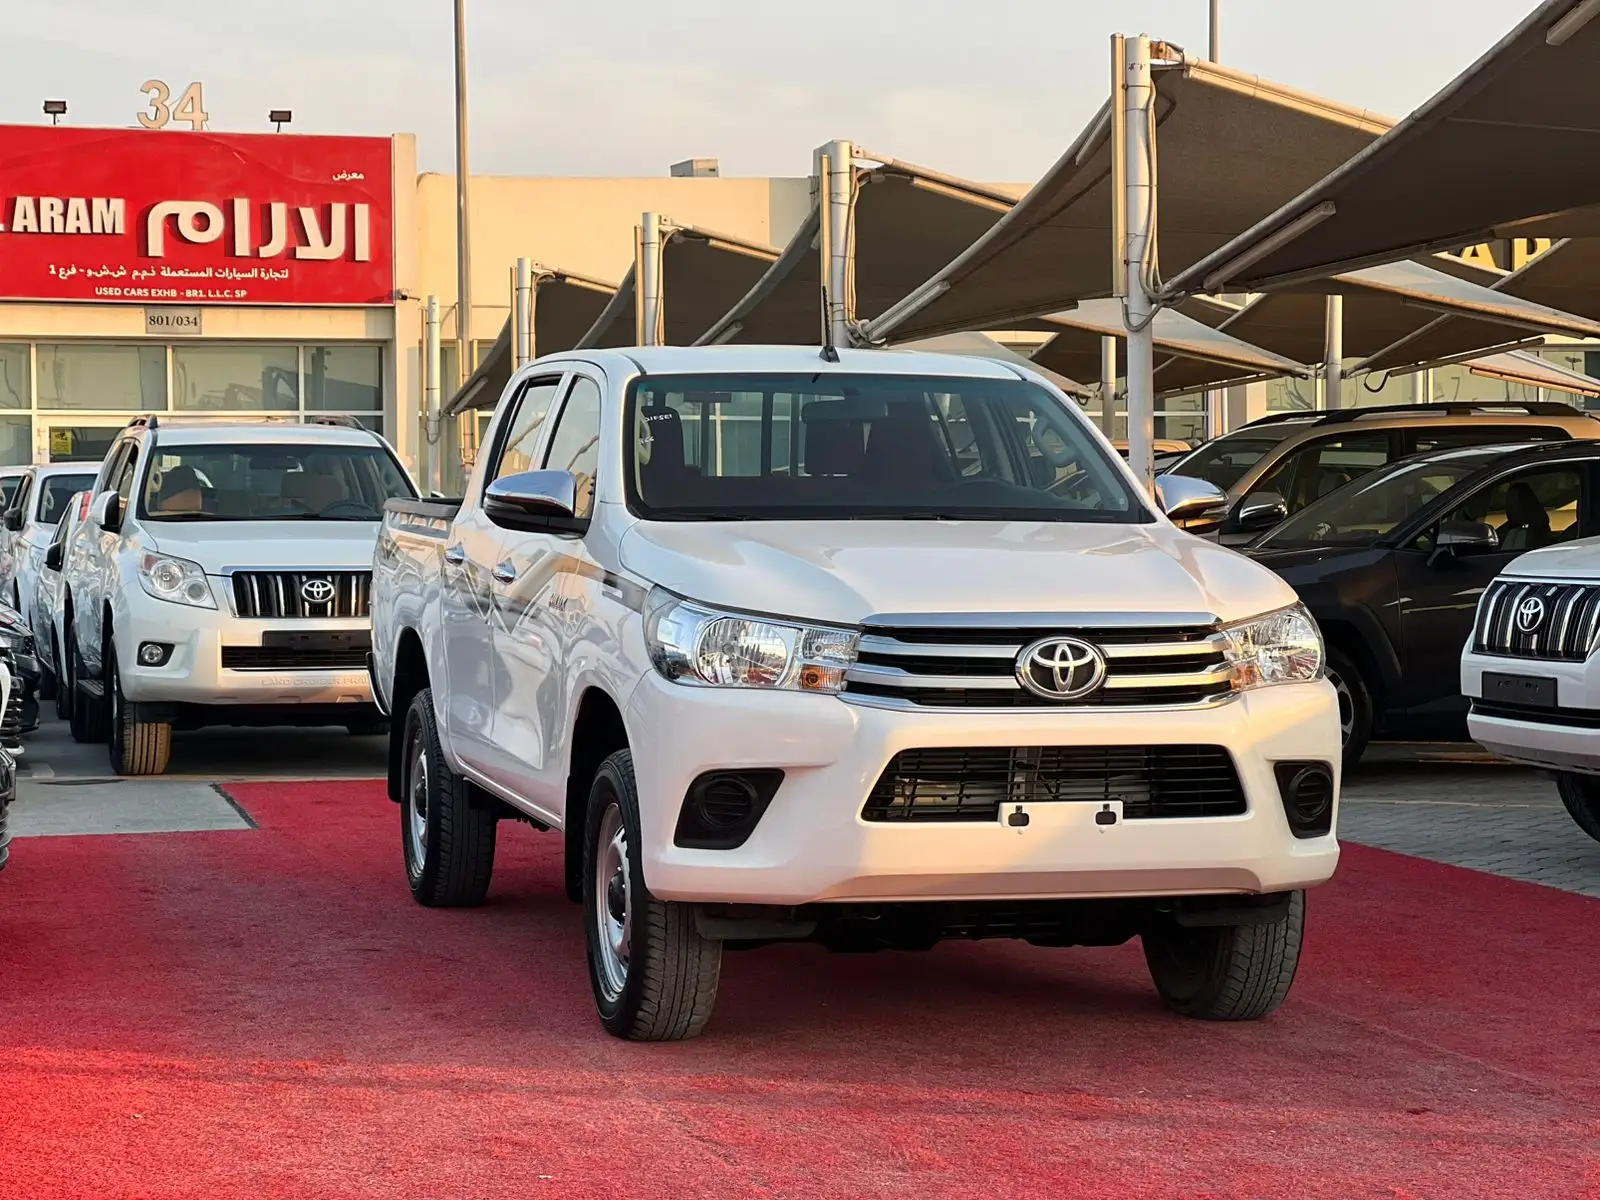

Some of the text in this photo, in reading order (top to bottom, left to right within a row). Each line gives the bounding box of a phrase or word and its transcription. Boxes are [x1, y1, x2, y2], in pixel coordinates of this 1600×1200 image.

[137, 80, 208, 130] 34
[332, 170, 365, 181] معرض
[12, 196, 125, 234] ARAM
[49, 264, 56, 275] 1
[58, 264, 77, 279] فرع
[160, 266, 213, 277] المستعملة
[214, 267, 258, 280] السيارات
[260, 268, 289, 281] لتجارة
[95, 286, 121, 296] USED
[123, 287, 149, 297] CARS
[151, 288, 177, 297] EXHB
[235, 289, 248, 298] SP
[148, 315, 198, 326] 801/034
[261, 677, 291, 686] LAND
[293, 677, 341, 686] CRUISER
